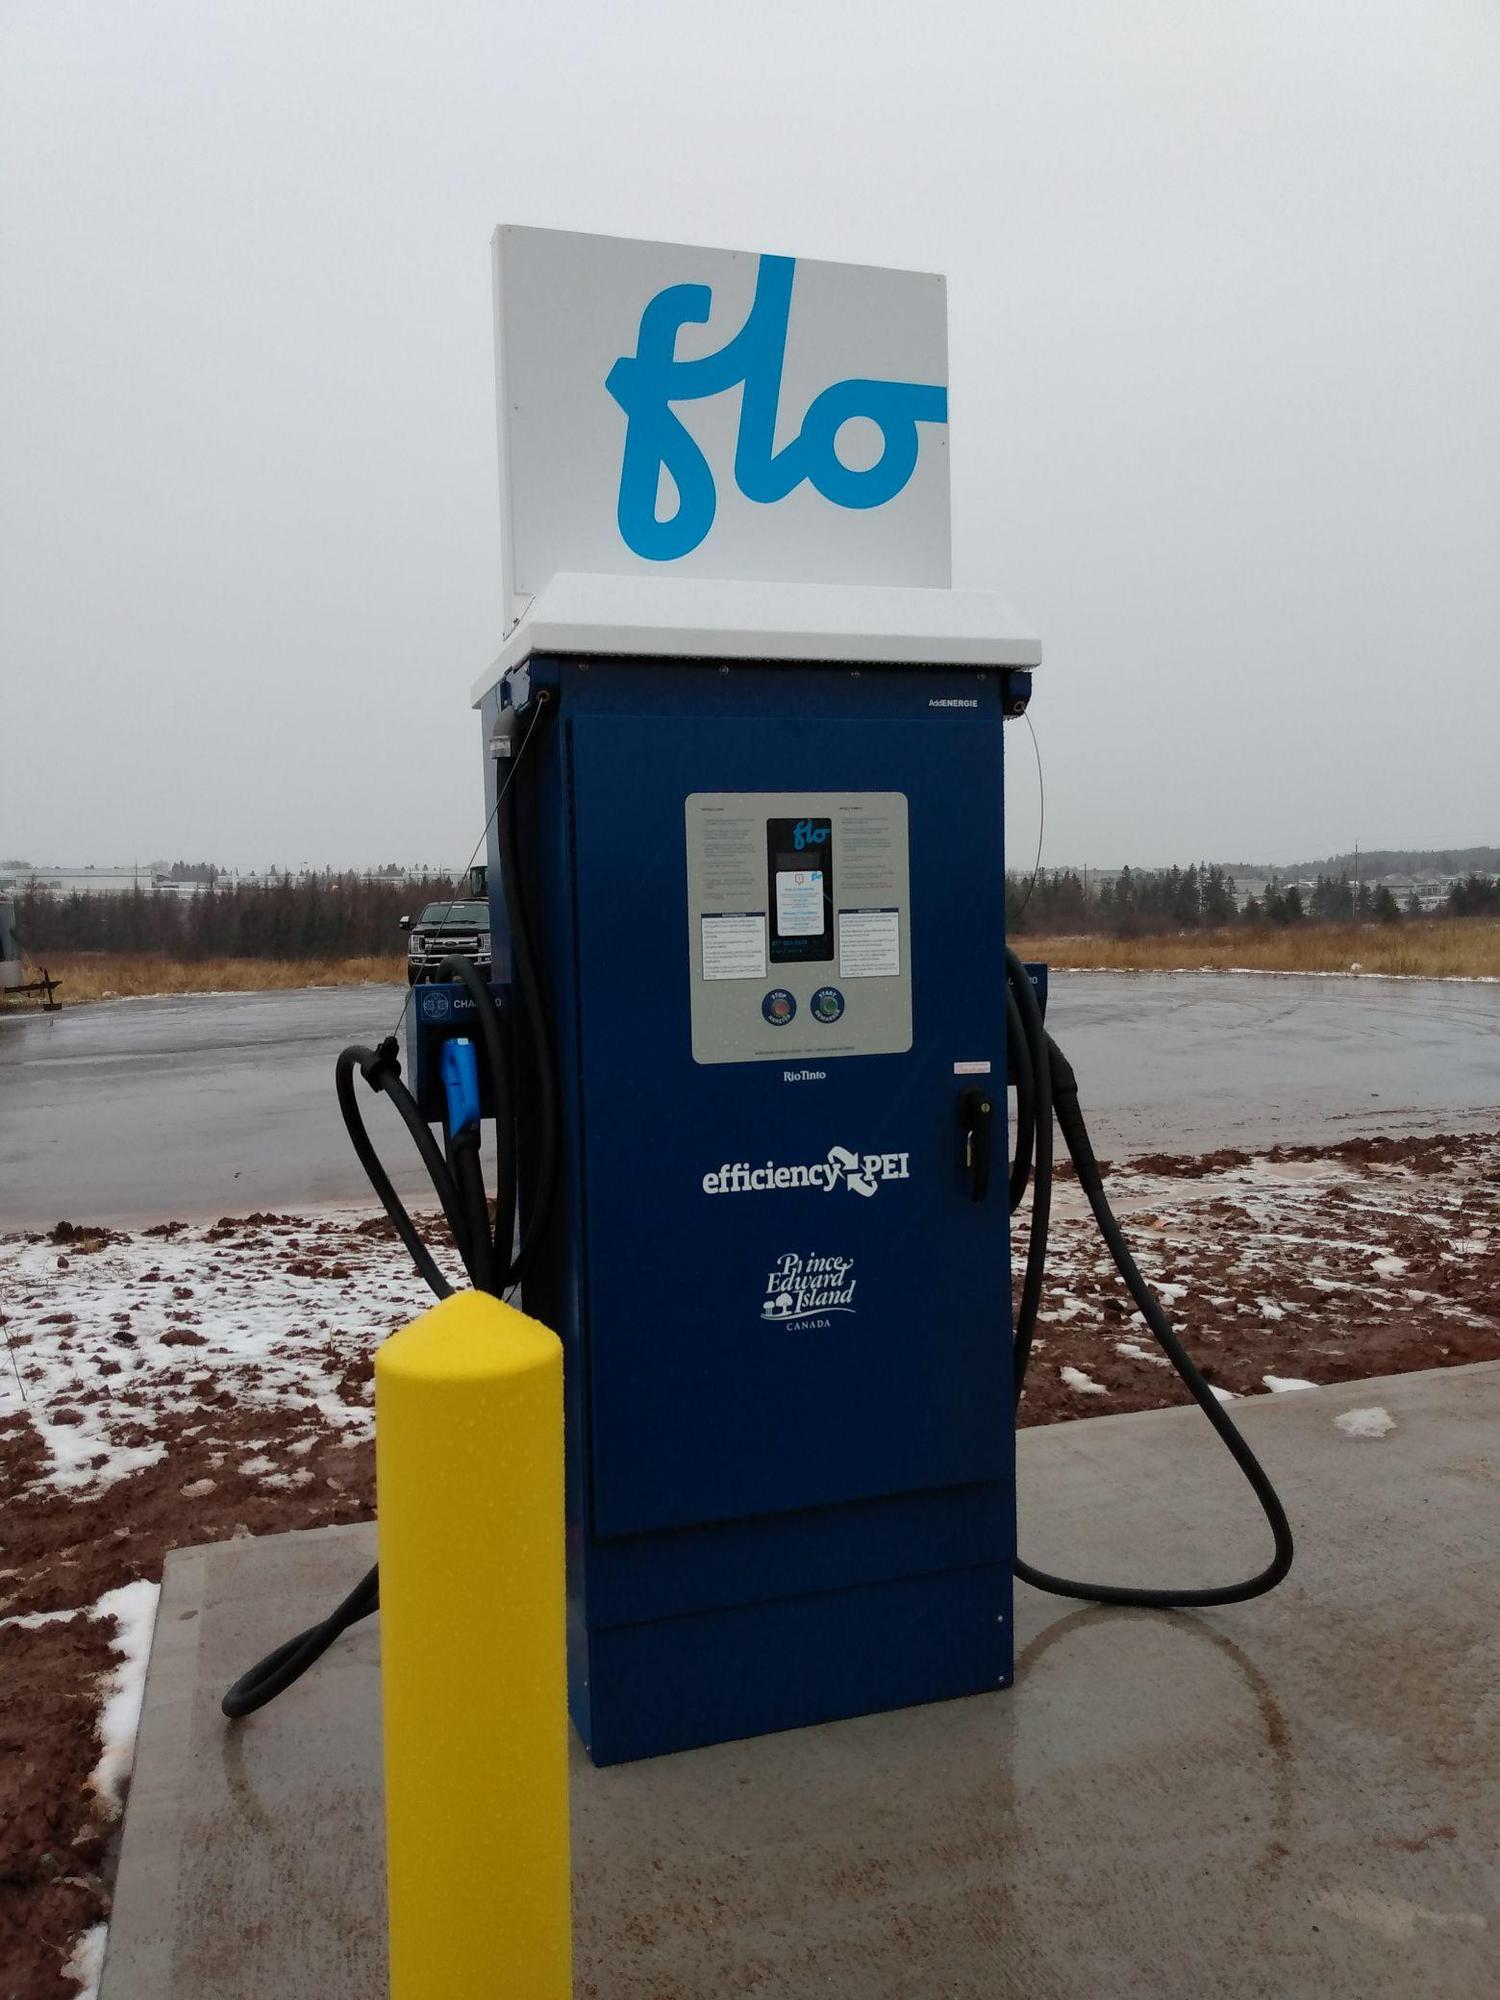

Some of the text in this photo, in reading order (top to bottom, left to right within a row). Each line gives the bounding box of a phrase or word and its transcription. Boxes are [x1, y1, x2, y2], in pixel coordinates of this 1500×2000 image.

[605, 253, 948, 562] flo
[793, 819, 832, 850] flo
[702, 1153, 910, 1194] efficiency PEI
[766, 1264, 846, 1294] Edward
[776, 1251, 854, 1276] Prince
[793, 1280, 857, 1314] Island
[786, 1319, 831, 1332] CANADA
